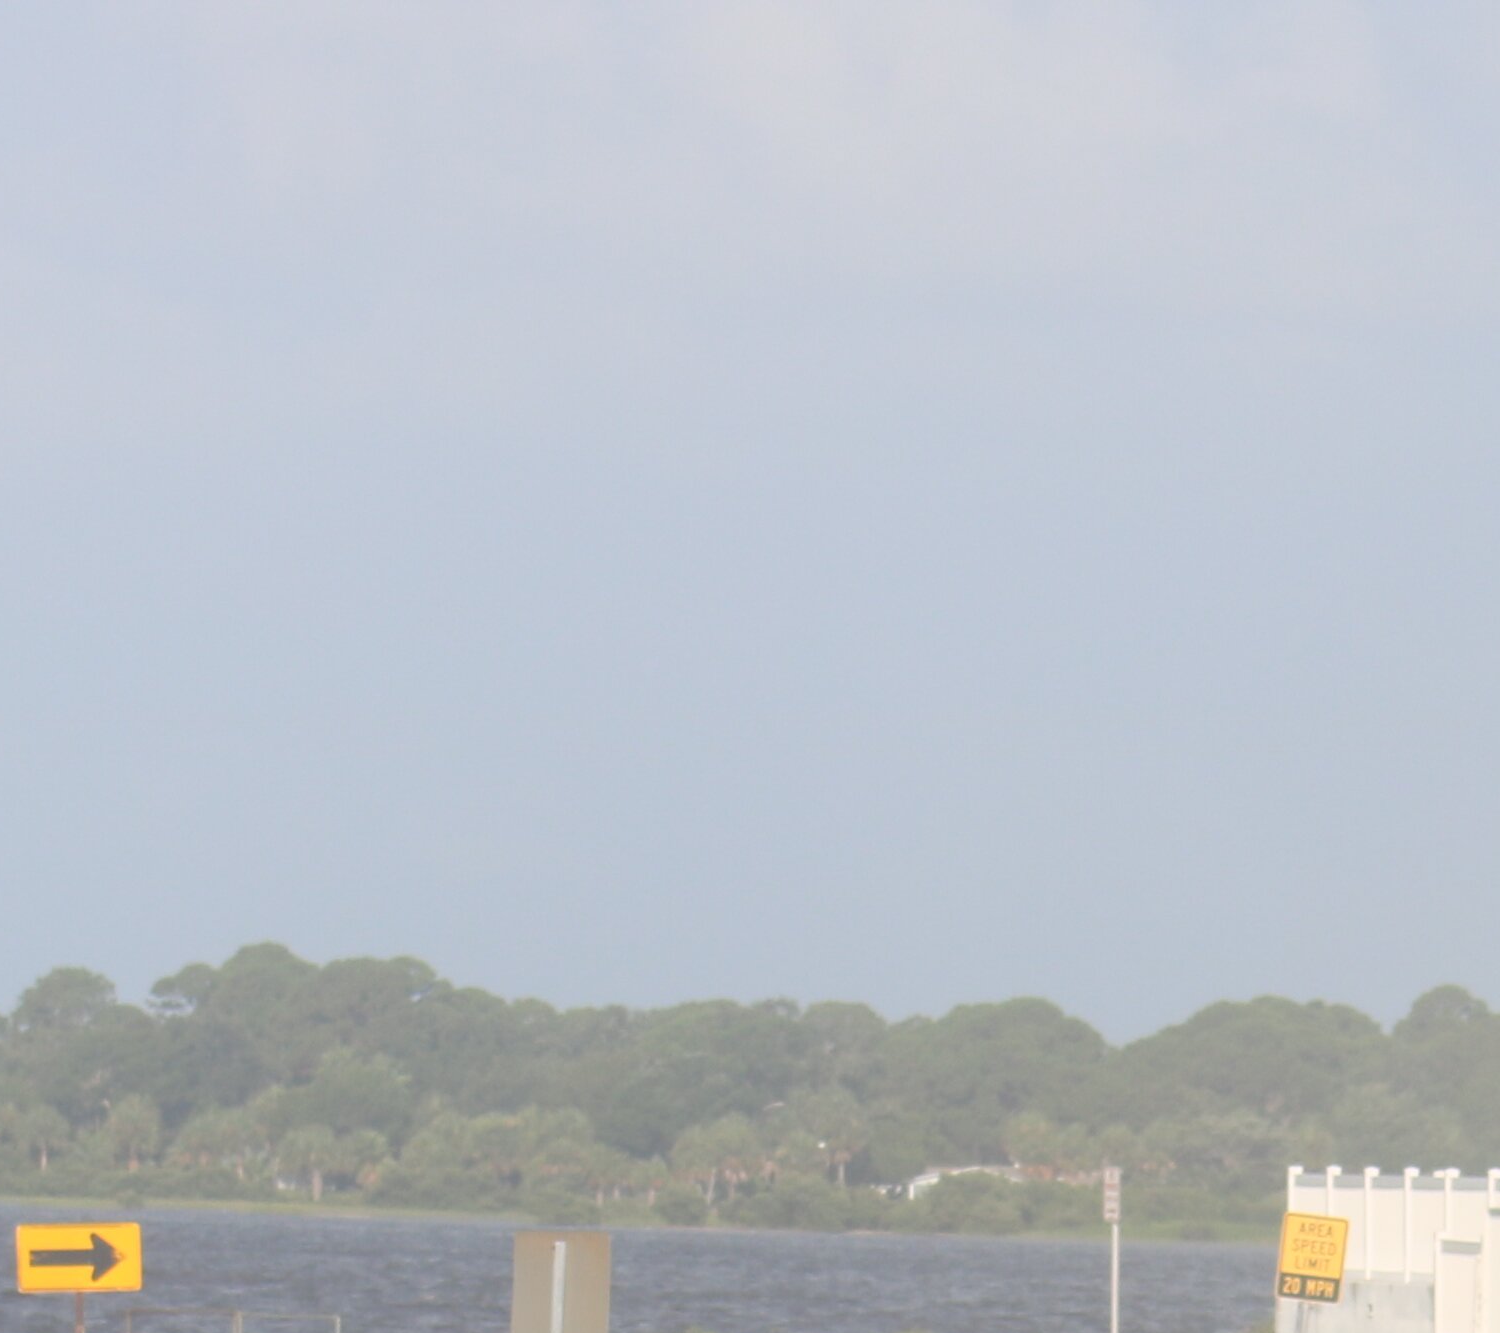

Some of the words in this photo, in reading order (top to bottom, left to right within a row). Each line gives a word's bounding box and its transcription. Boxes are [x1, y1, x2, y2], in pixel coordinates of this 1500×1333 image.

[1299, 1222, 1333, 1238] AREA
[1291, 1238, 1337, 1256] SPEED
[1294, 1256, 1332, 1273] LIMIT
[1283, 1277, 1301, 1295] 20
[1304, 1280, 1335, 1299] MPH
